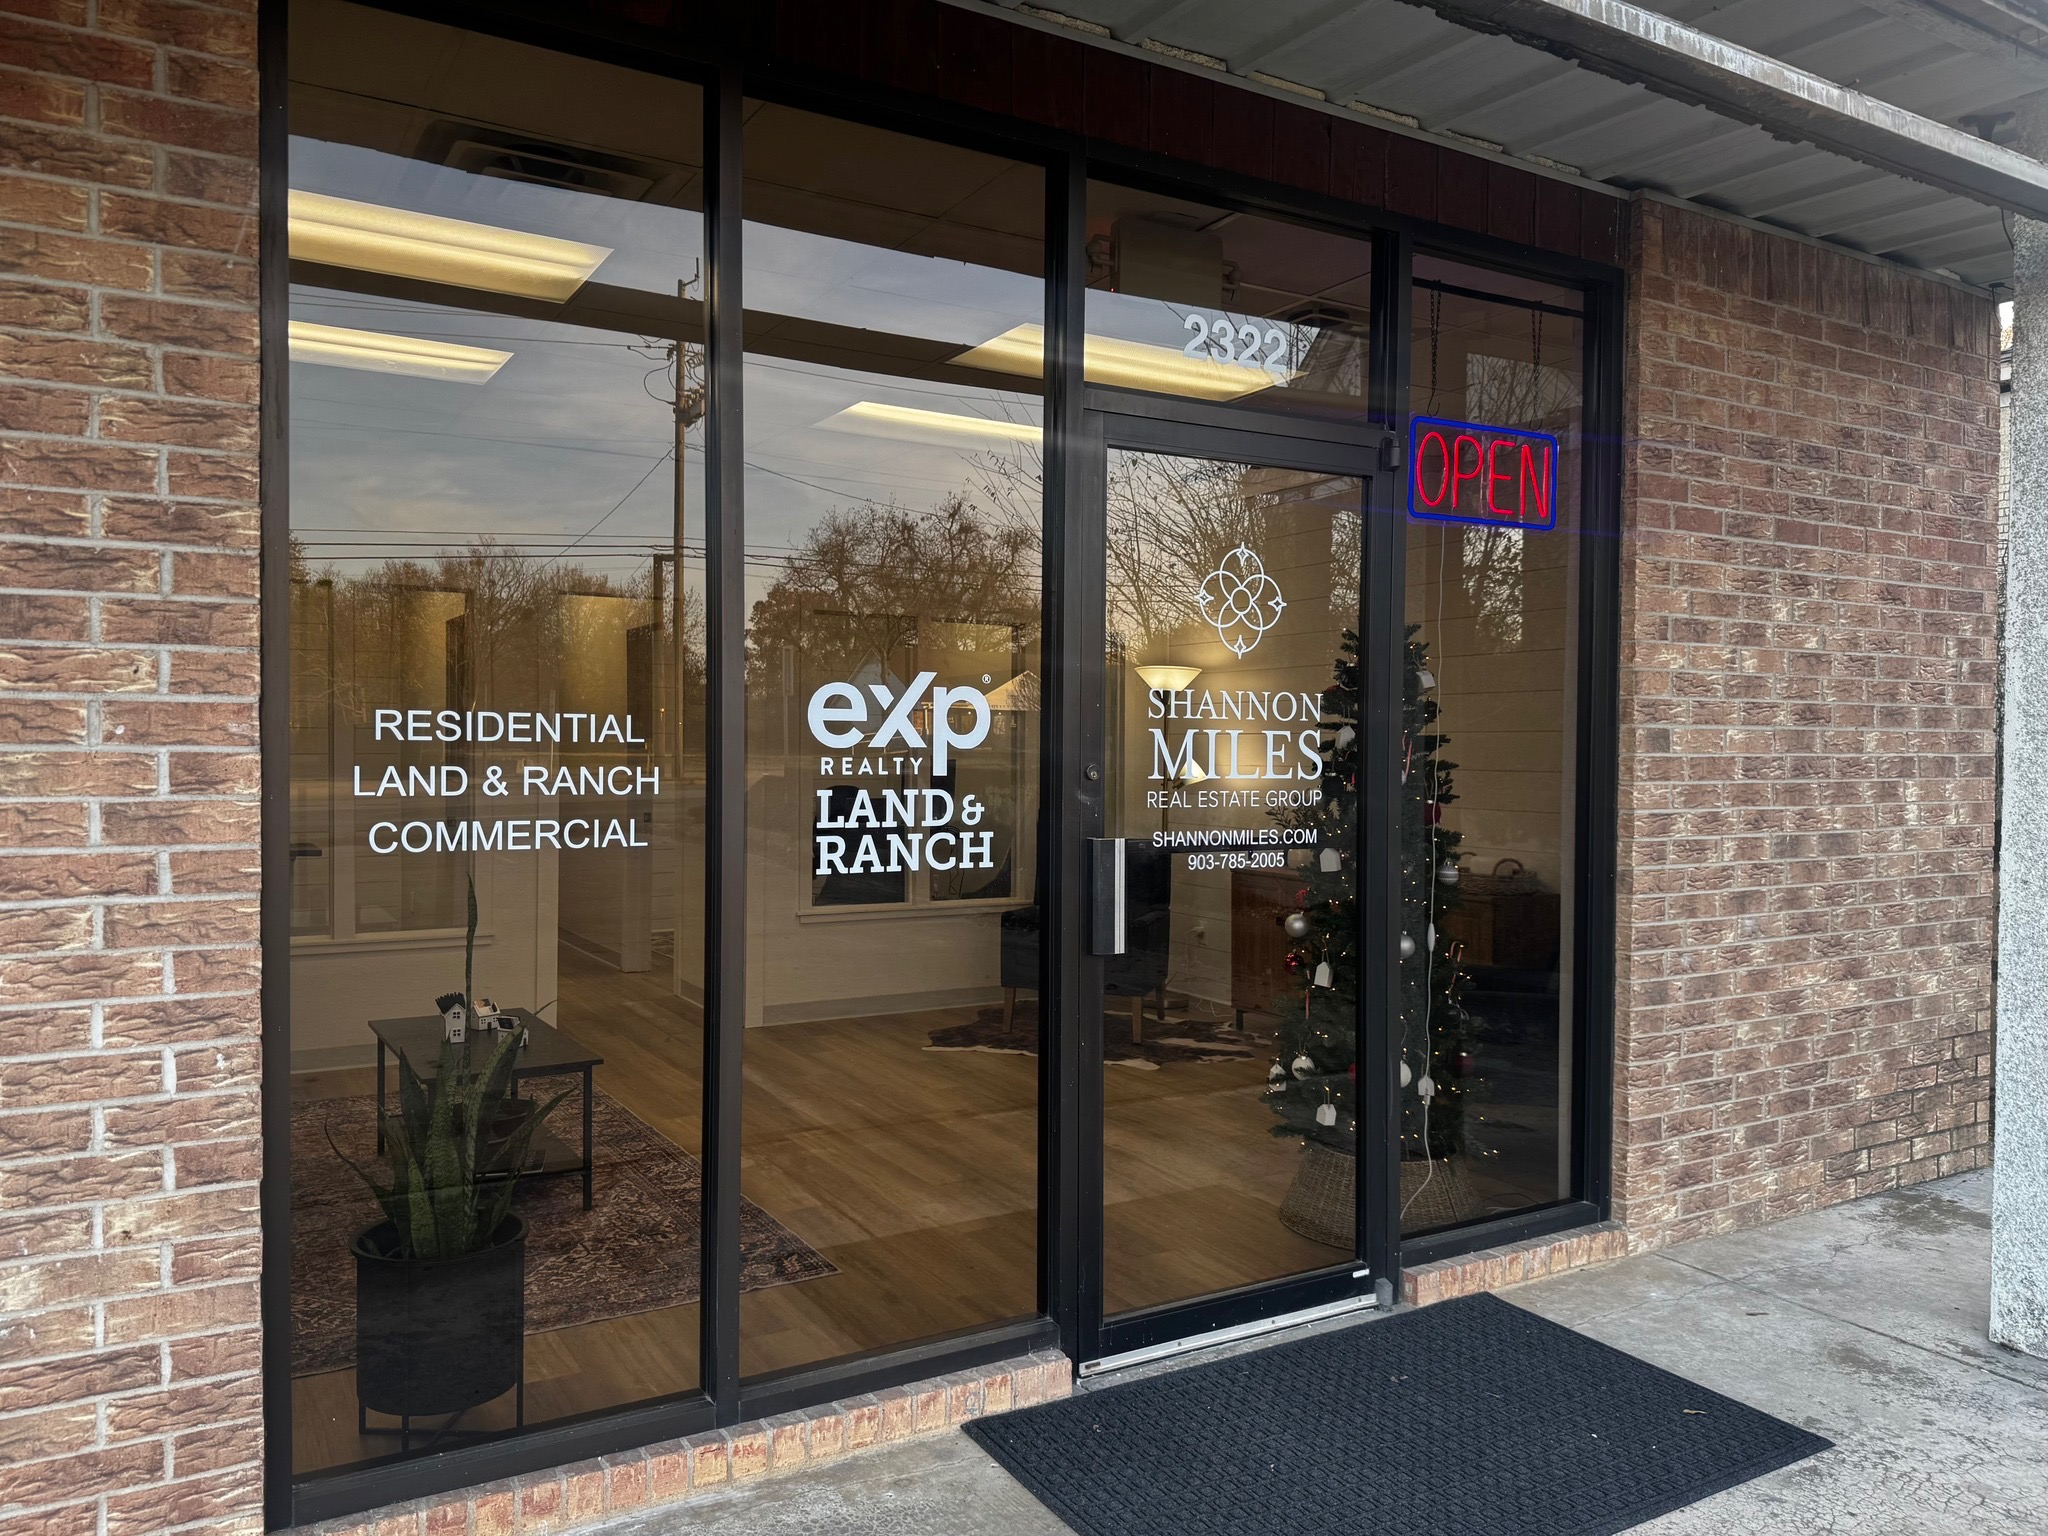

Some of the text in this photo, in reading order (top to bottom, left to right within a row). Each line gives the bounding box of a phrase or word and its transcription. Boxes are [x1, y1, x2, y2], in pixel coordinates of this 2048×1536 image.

[1183, 314, 1287, 373] 2322
[1416, 431, 1550, 518] OPEN
[1148, 688, 1323, 722] SHANNON
[374, 709, 645, 743] RESIDENTIAL
[820, 757, 923, 775] REALTY
[1148, 729, 1323, 780] MILES
[354, 765, 659, 797] LAND & RANCH
[816, 789, 984, 828] LAND &
[1147, 790, 1323, 808] REAL ESTATE GROUP
[368, 818, 648, 854] COMMERCIAL
[816, 831, 994, 875] RANCH
[1152, 828, 1317, 848] SHANNONMILES.COM
[1188, 852, 1285, 871] 903-785-2005
